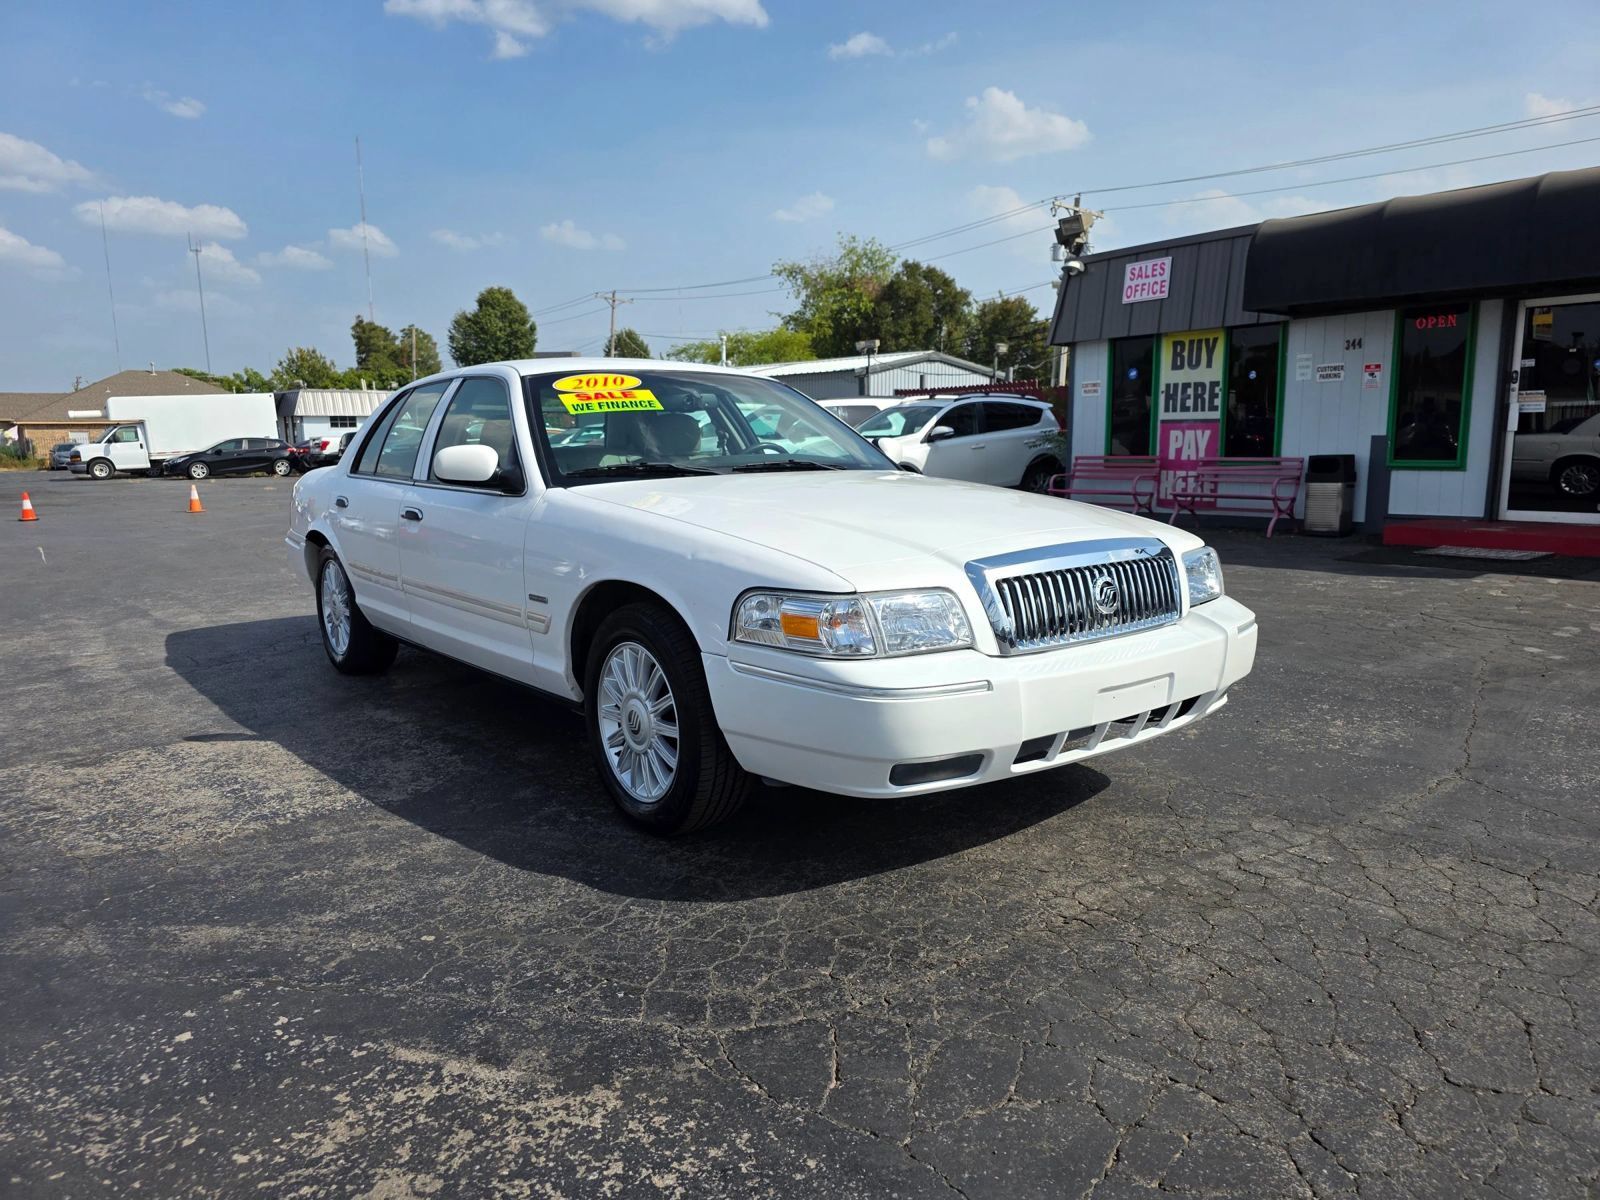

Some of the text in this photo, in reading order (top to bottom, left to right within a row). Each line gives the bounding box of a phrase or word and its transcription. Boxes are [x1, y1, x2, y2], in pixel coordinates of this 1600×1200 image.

[1129, 261, 1166, 282] SALES
[1125, 280, 1167, 299] OFFICE
[1416, 314, 1457, 329] OPEN
[1345, 338, 1362, 351] 344
[1171, 336, 1219, 371] BUY
[1317, 365, 1344, 373] CUSTOMER
[1319, 372, 1342, 380] PARKING
[573, 376, 625, 390] 2010
[575, 391, 637, 401] SALE
[1164, 381, 1221, 413] HERE
[572, 400, 656, 412] WE FINANCE
[1168, 429, 1211, 460] PAY
